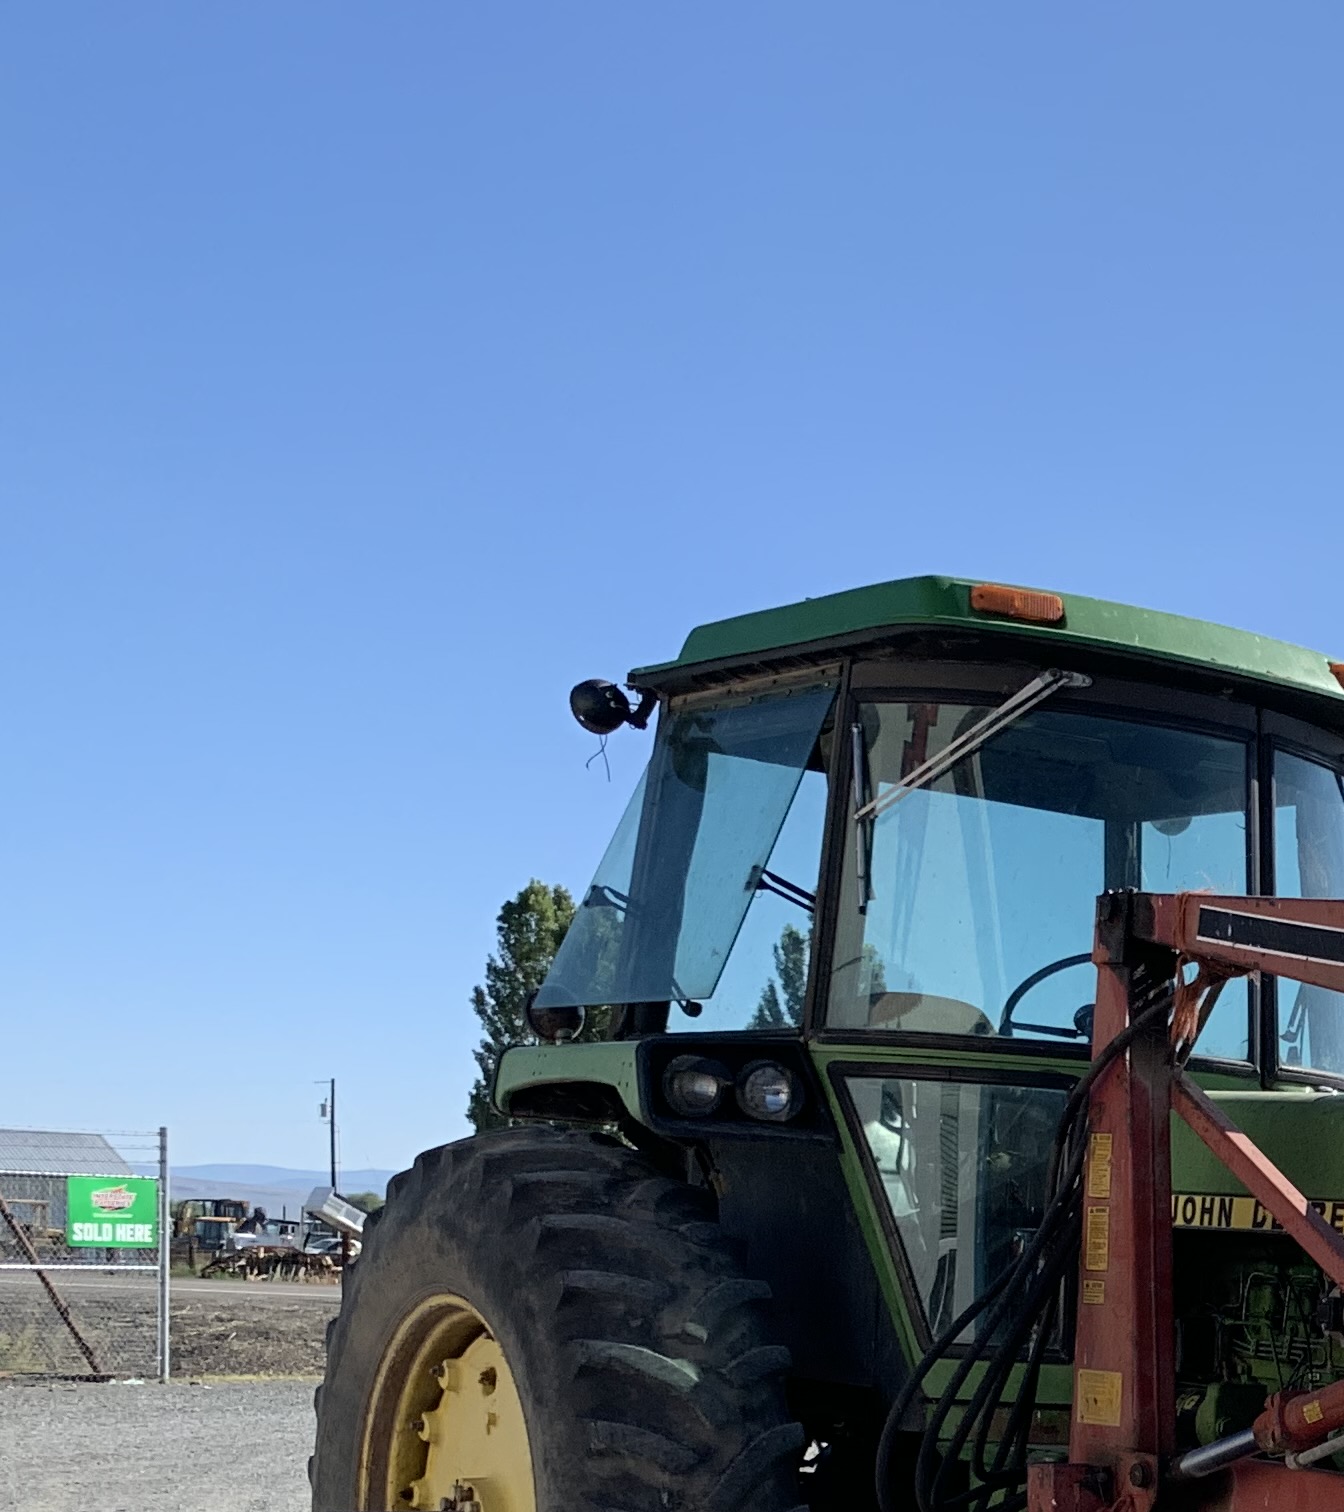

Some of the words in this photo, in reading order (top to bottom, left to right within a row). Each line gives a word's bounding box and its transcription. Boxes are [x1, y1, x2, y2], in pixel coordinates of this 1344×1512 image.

[1171, 1195, 1234, 1228] JOHN
[72, 1222, 113, 1242] SOLD
[115, 1223, 153, 1243] HERE
